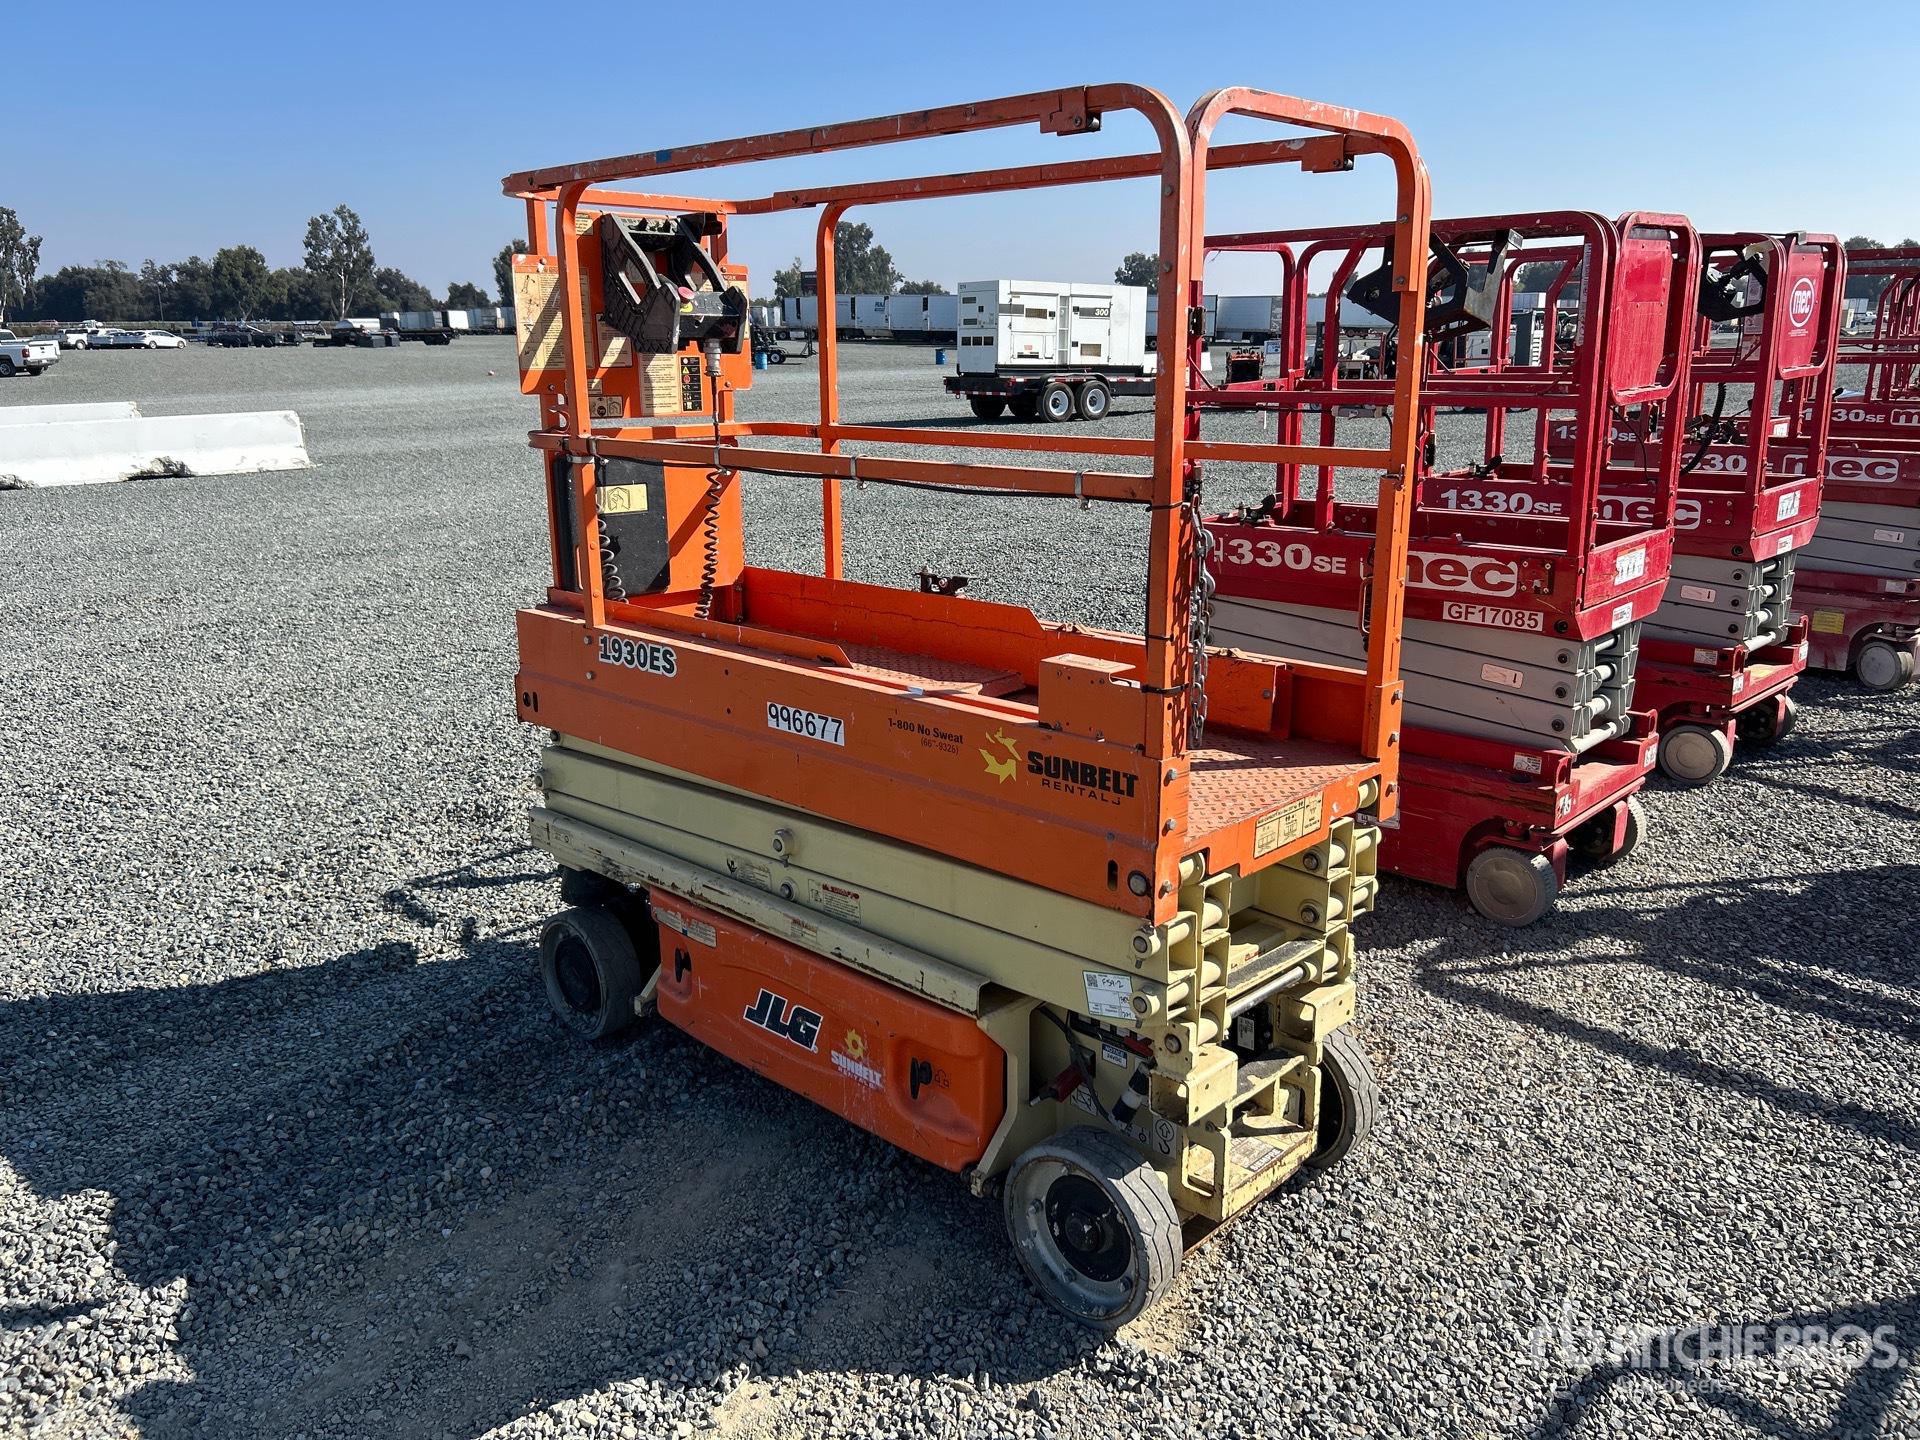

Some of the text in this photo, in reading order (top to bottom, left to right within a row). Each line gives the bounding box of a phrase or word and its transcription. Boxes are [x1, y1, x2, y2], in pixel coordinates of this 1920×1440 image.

[1094, 308, 1109, 316] 300
[1792, 290, 1812, 315] mec
[1801, 408, 1885, 424] 130SE
[1555, 425, 1637, 442] 13SE
[1440, 489, 1563, 515] 1330SE
[1447, 602, 1539, 629] GF17085
[599, 634, 677, 676] 1930ES
[768, 702, 843, 743] 996677
[887, 717, 964, 745] 1-800 No Sweat
[1027, 750, 1139, 798] SUNBELT
[742, 988, 824, 1050] JLG
[1104, 1045, 1125, 1058] NOTICE
[831, 1050, 882, 1086] SUNBELT
